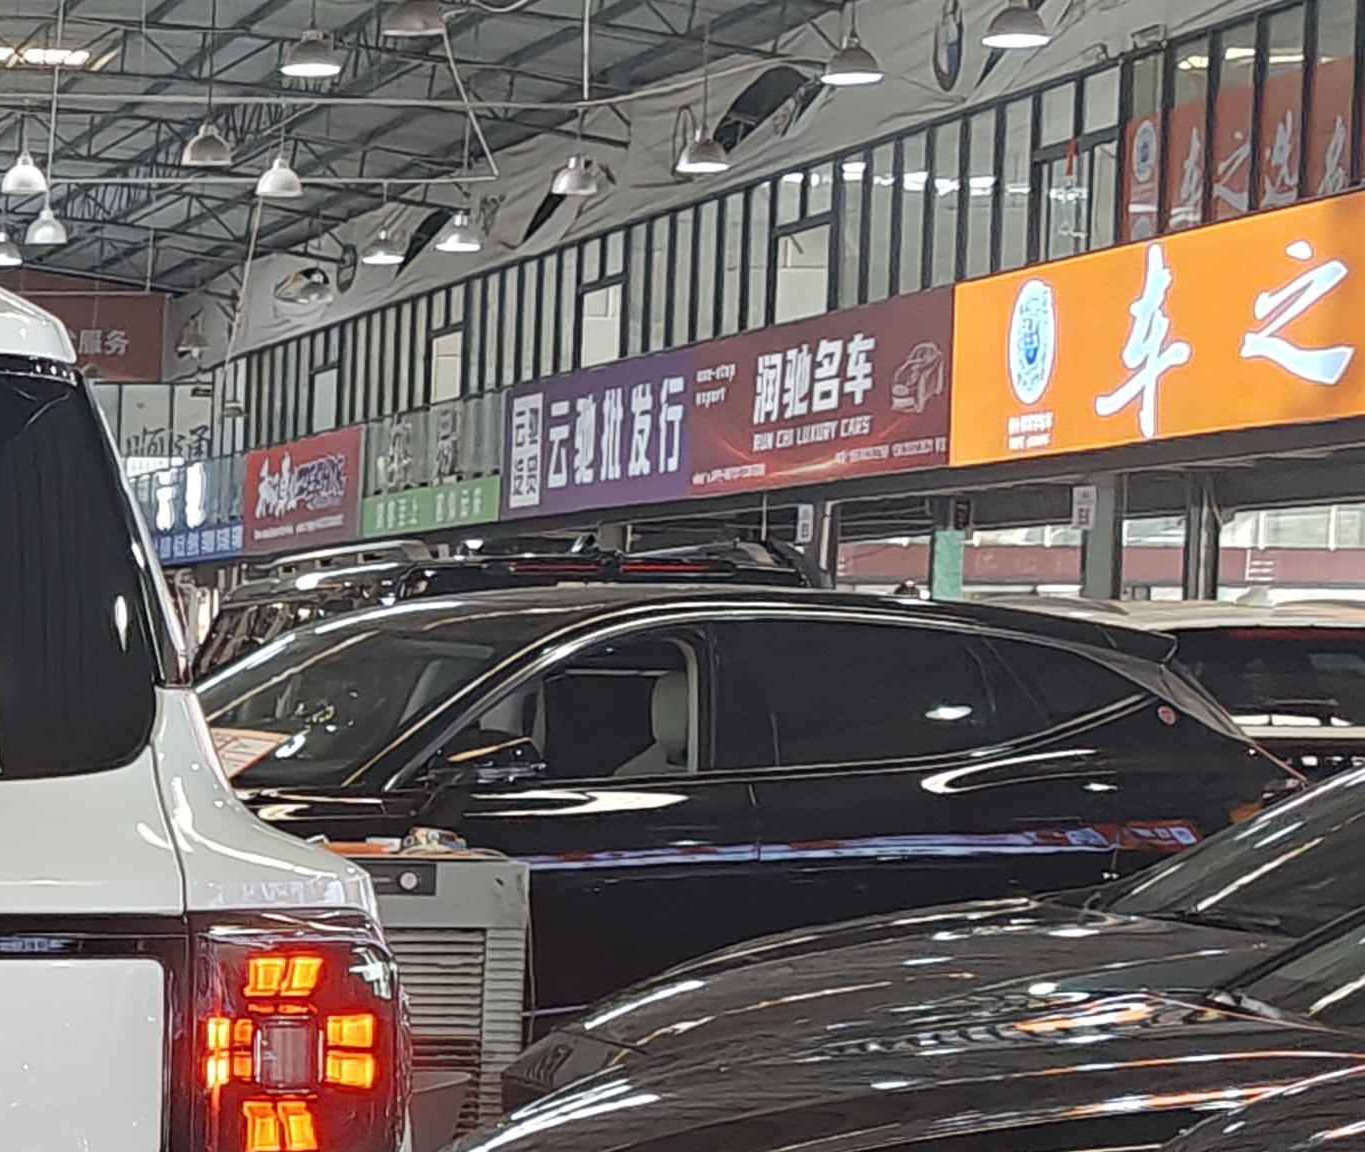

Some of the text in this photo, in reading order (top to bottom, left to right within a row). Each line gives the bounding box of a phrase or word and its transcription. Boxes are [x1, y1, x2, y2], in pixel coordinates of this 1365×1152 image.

[68, 328, 129, 356] 服务
[1094, 241, 1356, 439] 车之
[752, 331, 877, 425] 润驰名车
[796, 419, 839, 446] LUXURY
[840, 416, 874, 438] CARS
